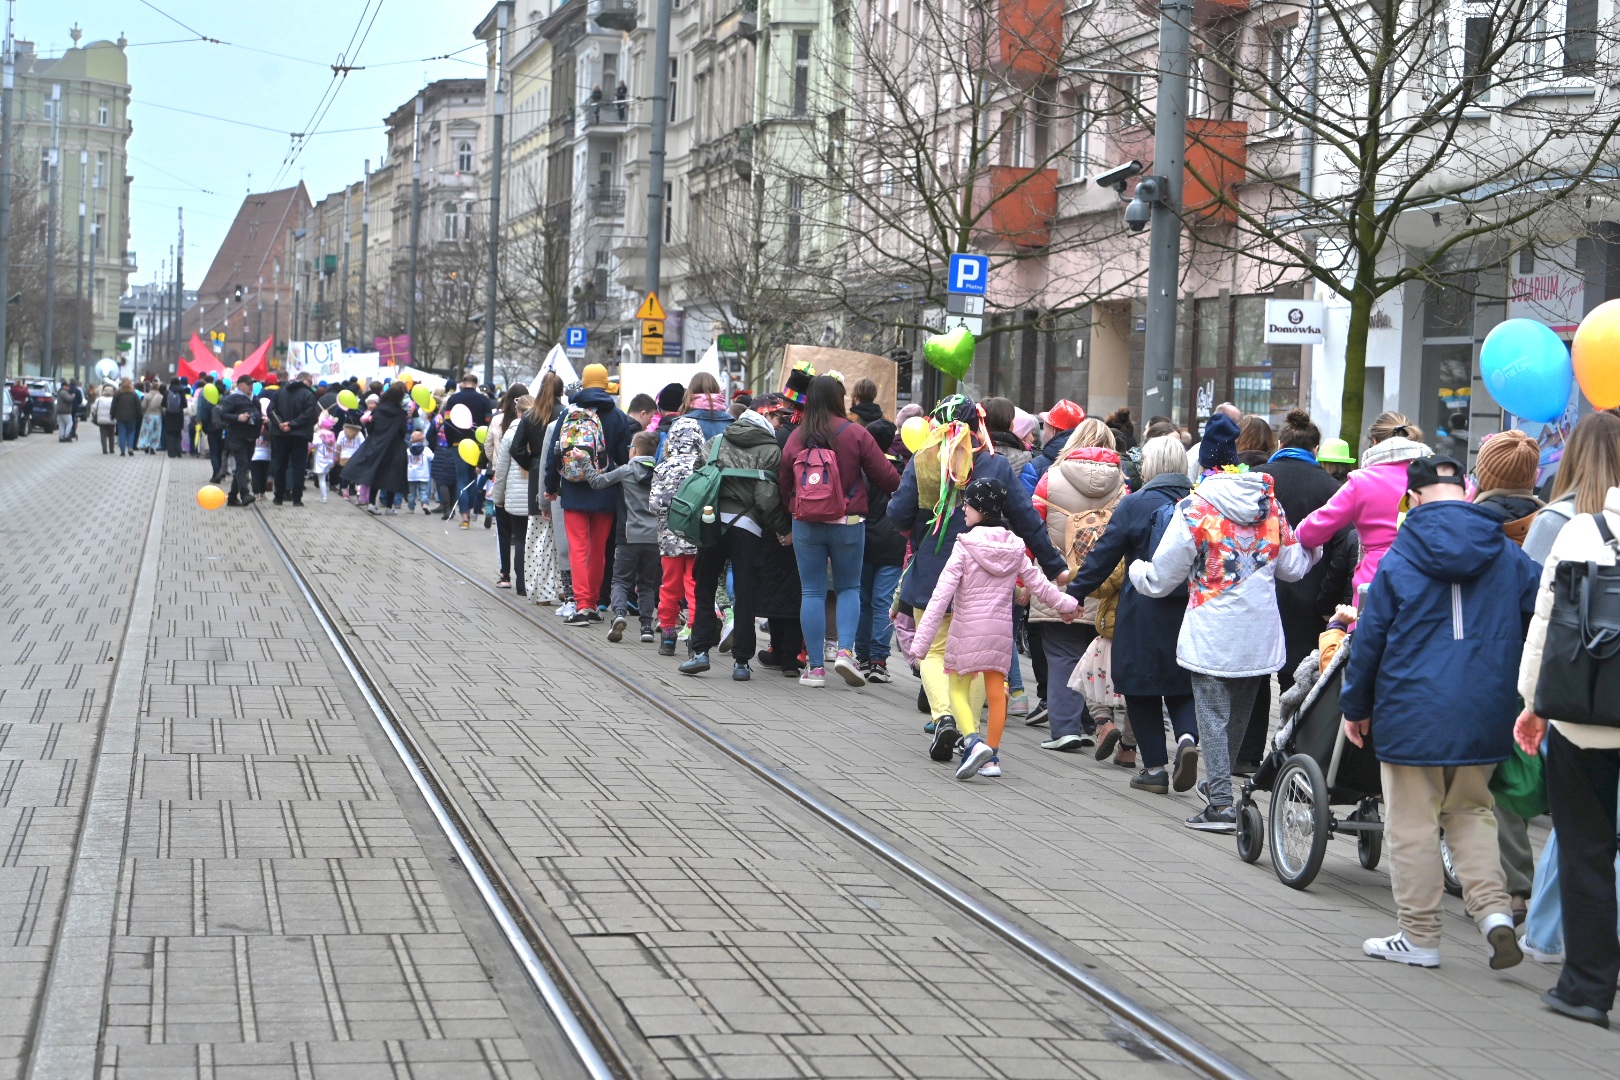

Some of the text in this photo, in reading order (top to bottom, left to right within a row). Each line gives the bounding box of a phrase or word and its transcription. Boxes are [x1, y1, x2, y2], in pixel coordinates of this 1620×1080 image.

[956, 258, 980, 288] P
[1511, 275, 1559, 303] SOLARIUM
[570, 329, 583, 346] P
[1269, 323, 1321, 335] Domówka
